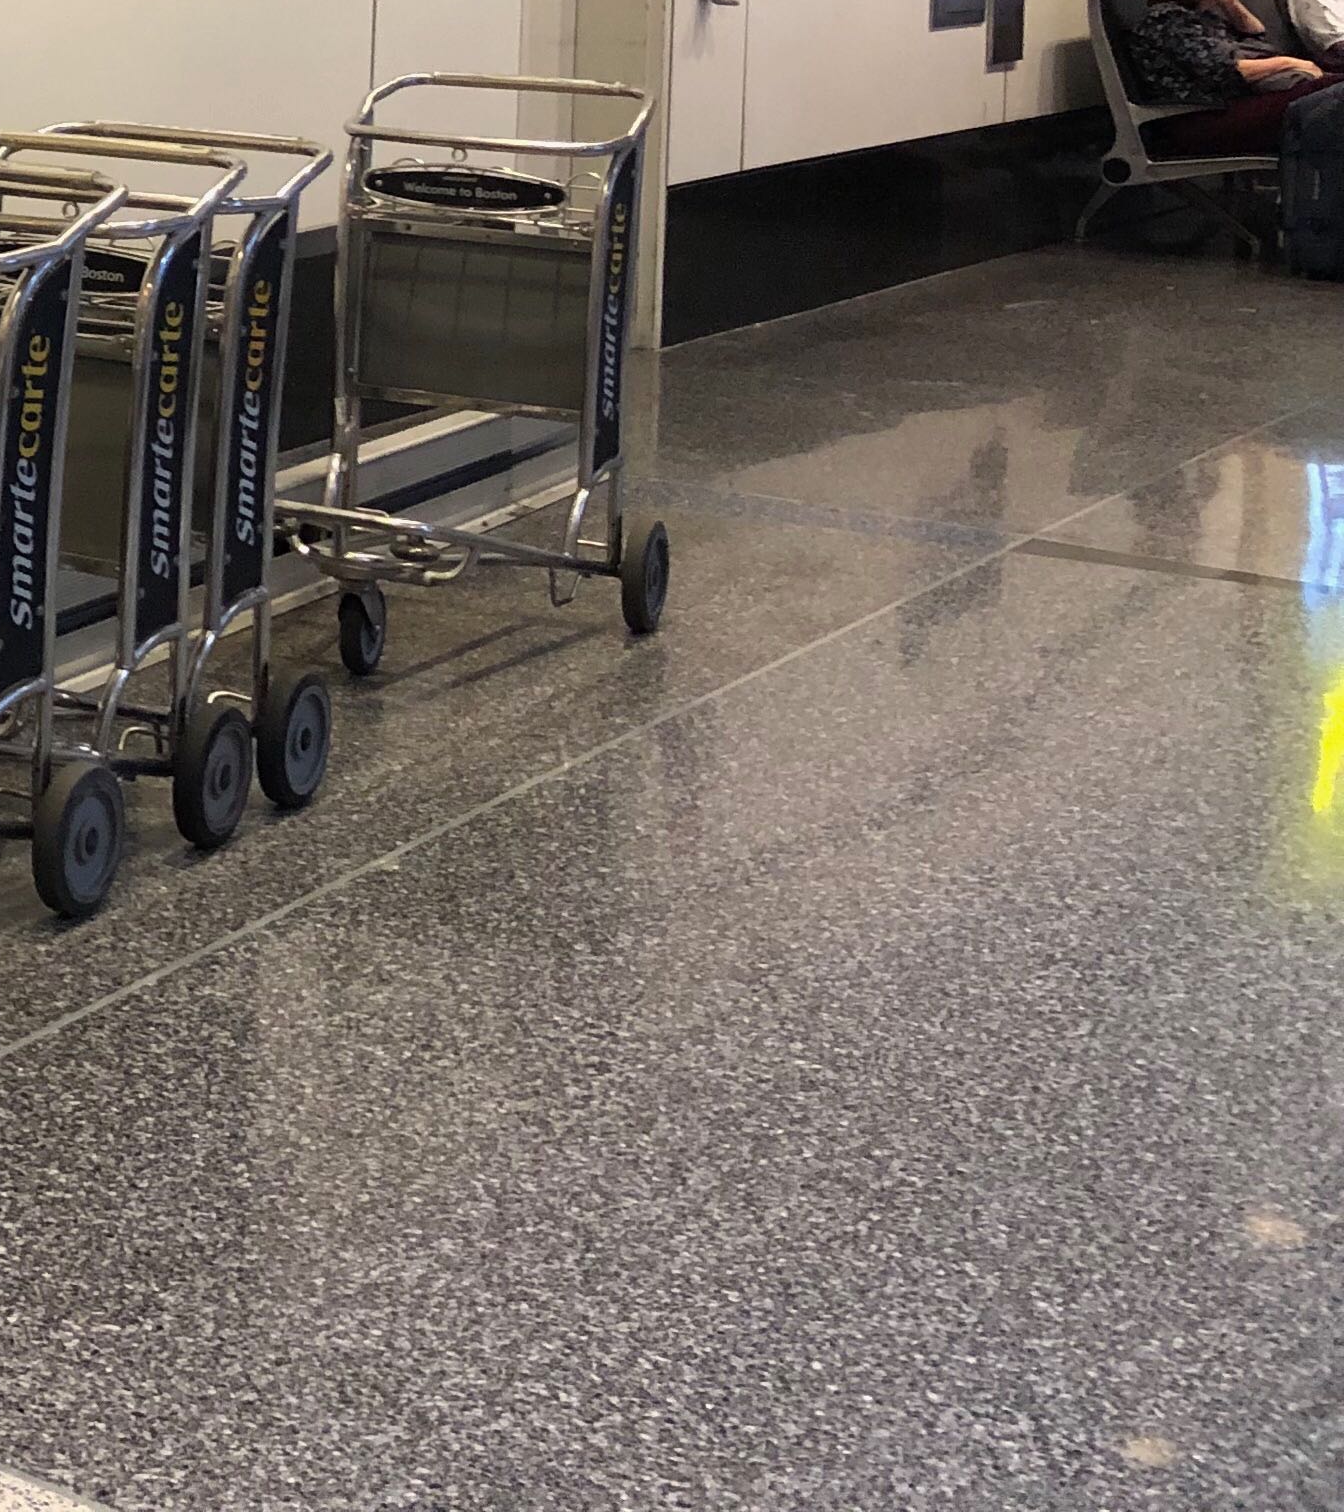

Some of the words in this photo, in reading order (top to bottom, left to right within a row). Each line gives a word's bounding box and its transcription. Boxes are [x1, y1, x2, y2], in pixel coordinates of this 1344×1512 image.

[403, 180, 456, 197] Welcome
[459, 187, 473, 198] to
[474, 187, 518, 201] Boston
[602, 202, 626, 423] smartecarte
[10, 334, 51, 631] smartecarte
[150, 300, 185, 580] smartecarte
[235, 279, 273, 546] smartecarte
